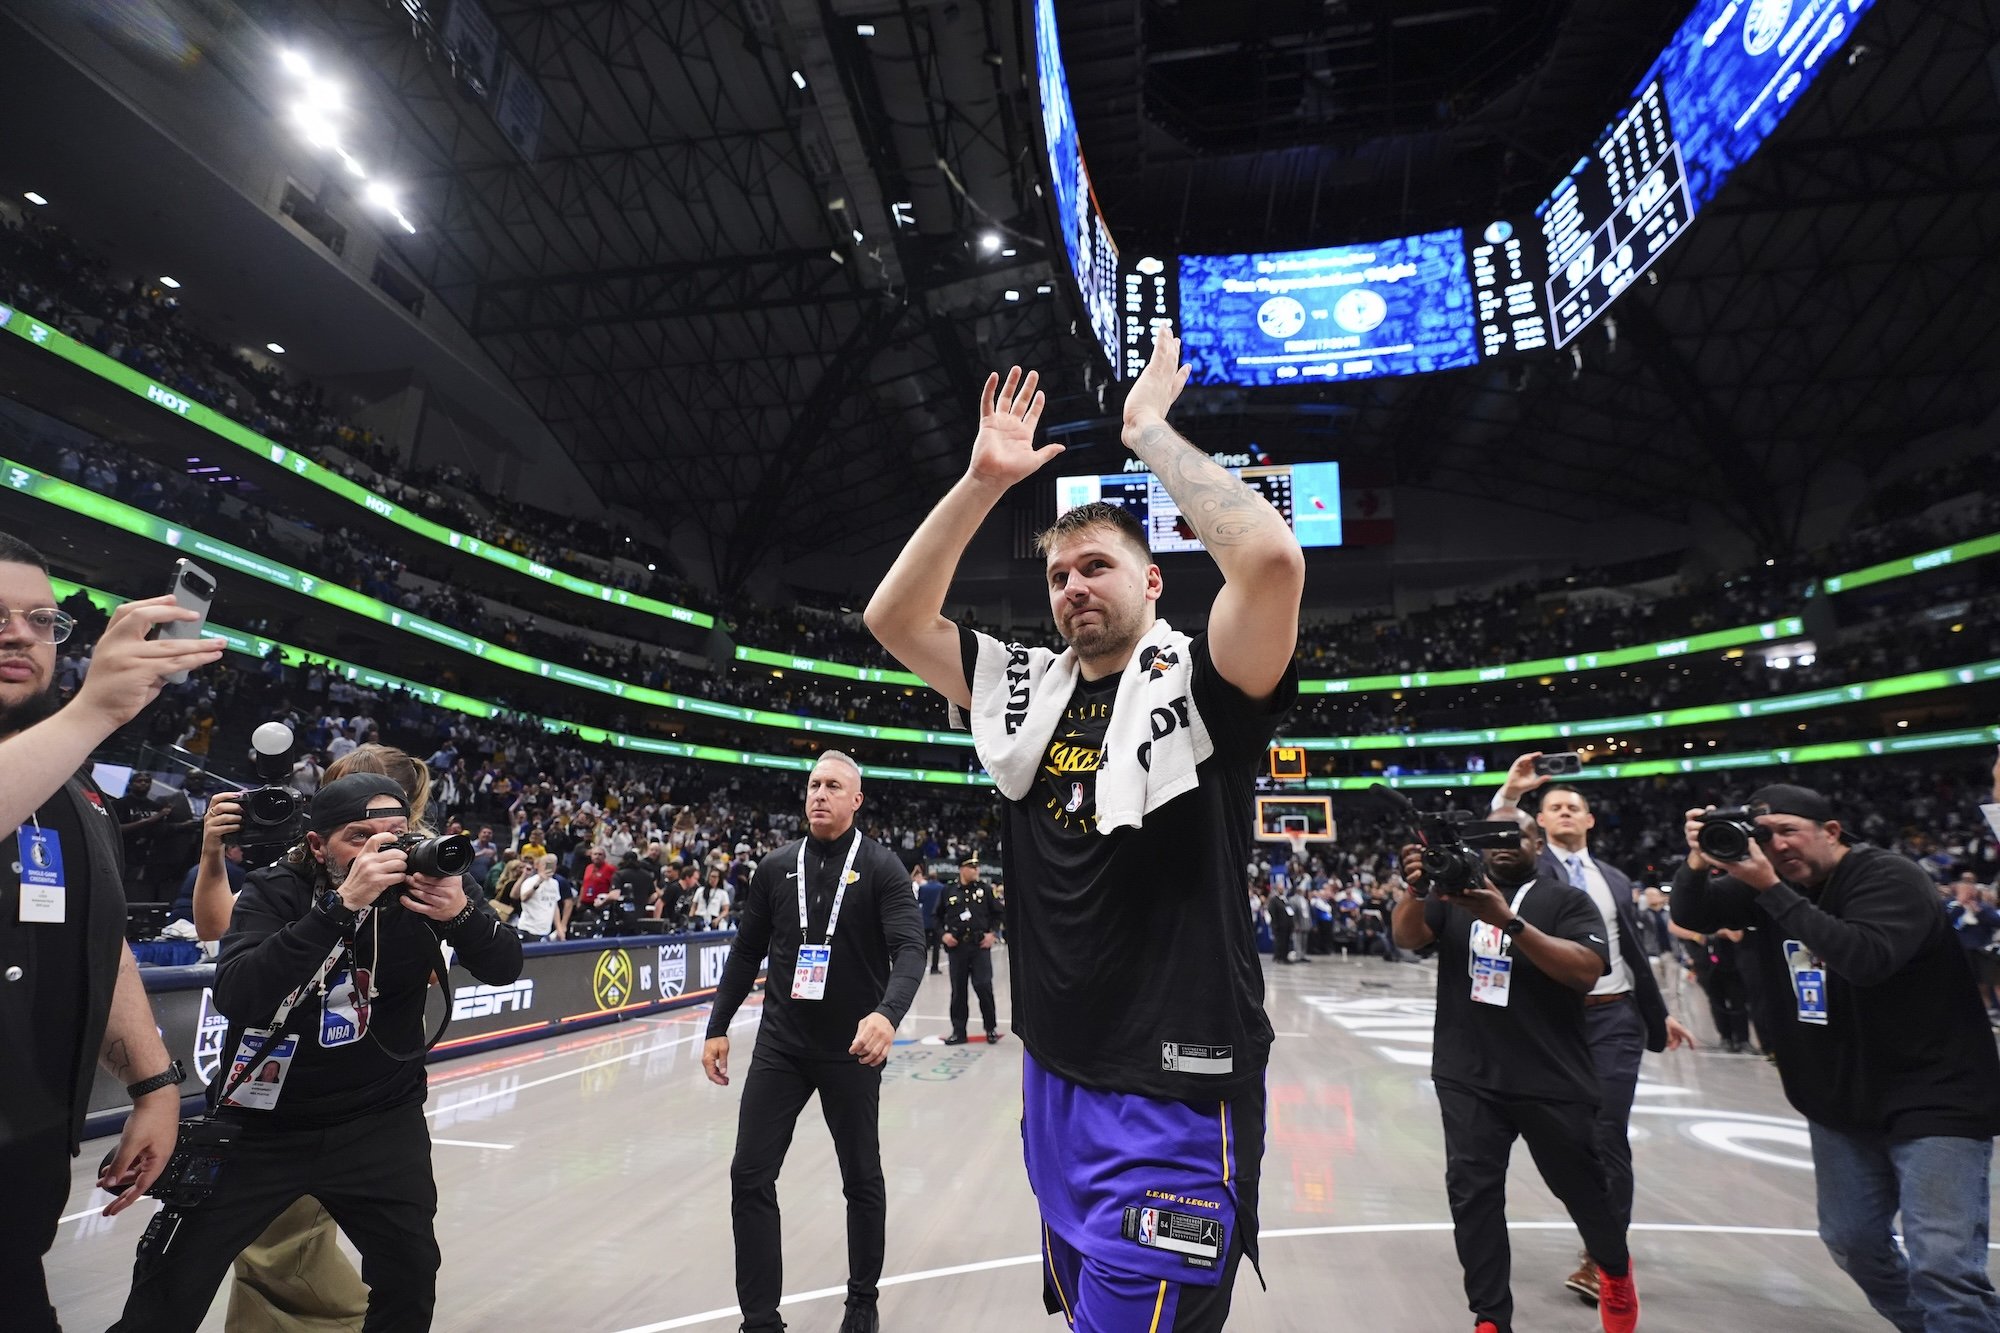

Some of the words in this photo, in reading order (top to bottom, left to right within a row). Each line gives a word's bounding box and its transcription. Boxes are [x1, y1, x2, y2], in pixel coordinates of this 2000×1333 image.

[1565, 244, 1596, 289] 97
[147, 384, 191, 415] HOT
[365, 495, 393, 517] HOT
[529, 562, 553, 580] HOT
[671, 608, 693, 622] HOT
[792, 657, 815, 671] HOT
[450, 979, 534, 1022] ESPN
[326, 1024, 350, 1042] NBA
[1145, 1189, 1177, 1202] LEAVE
[1177, 1195, 1184, 1204] A
[1185, 1197, 1220, 1209] LEGACY
